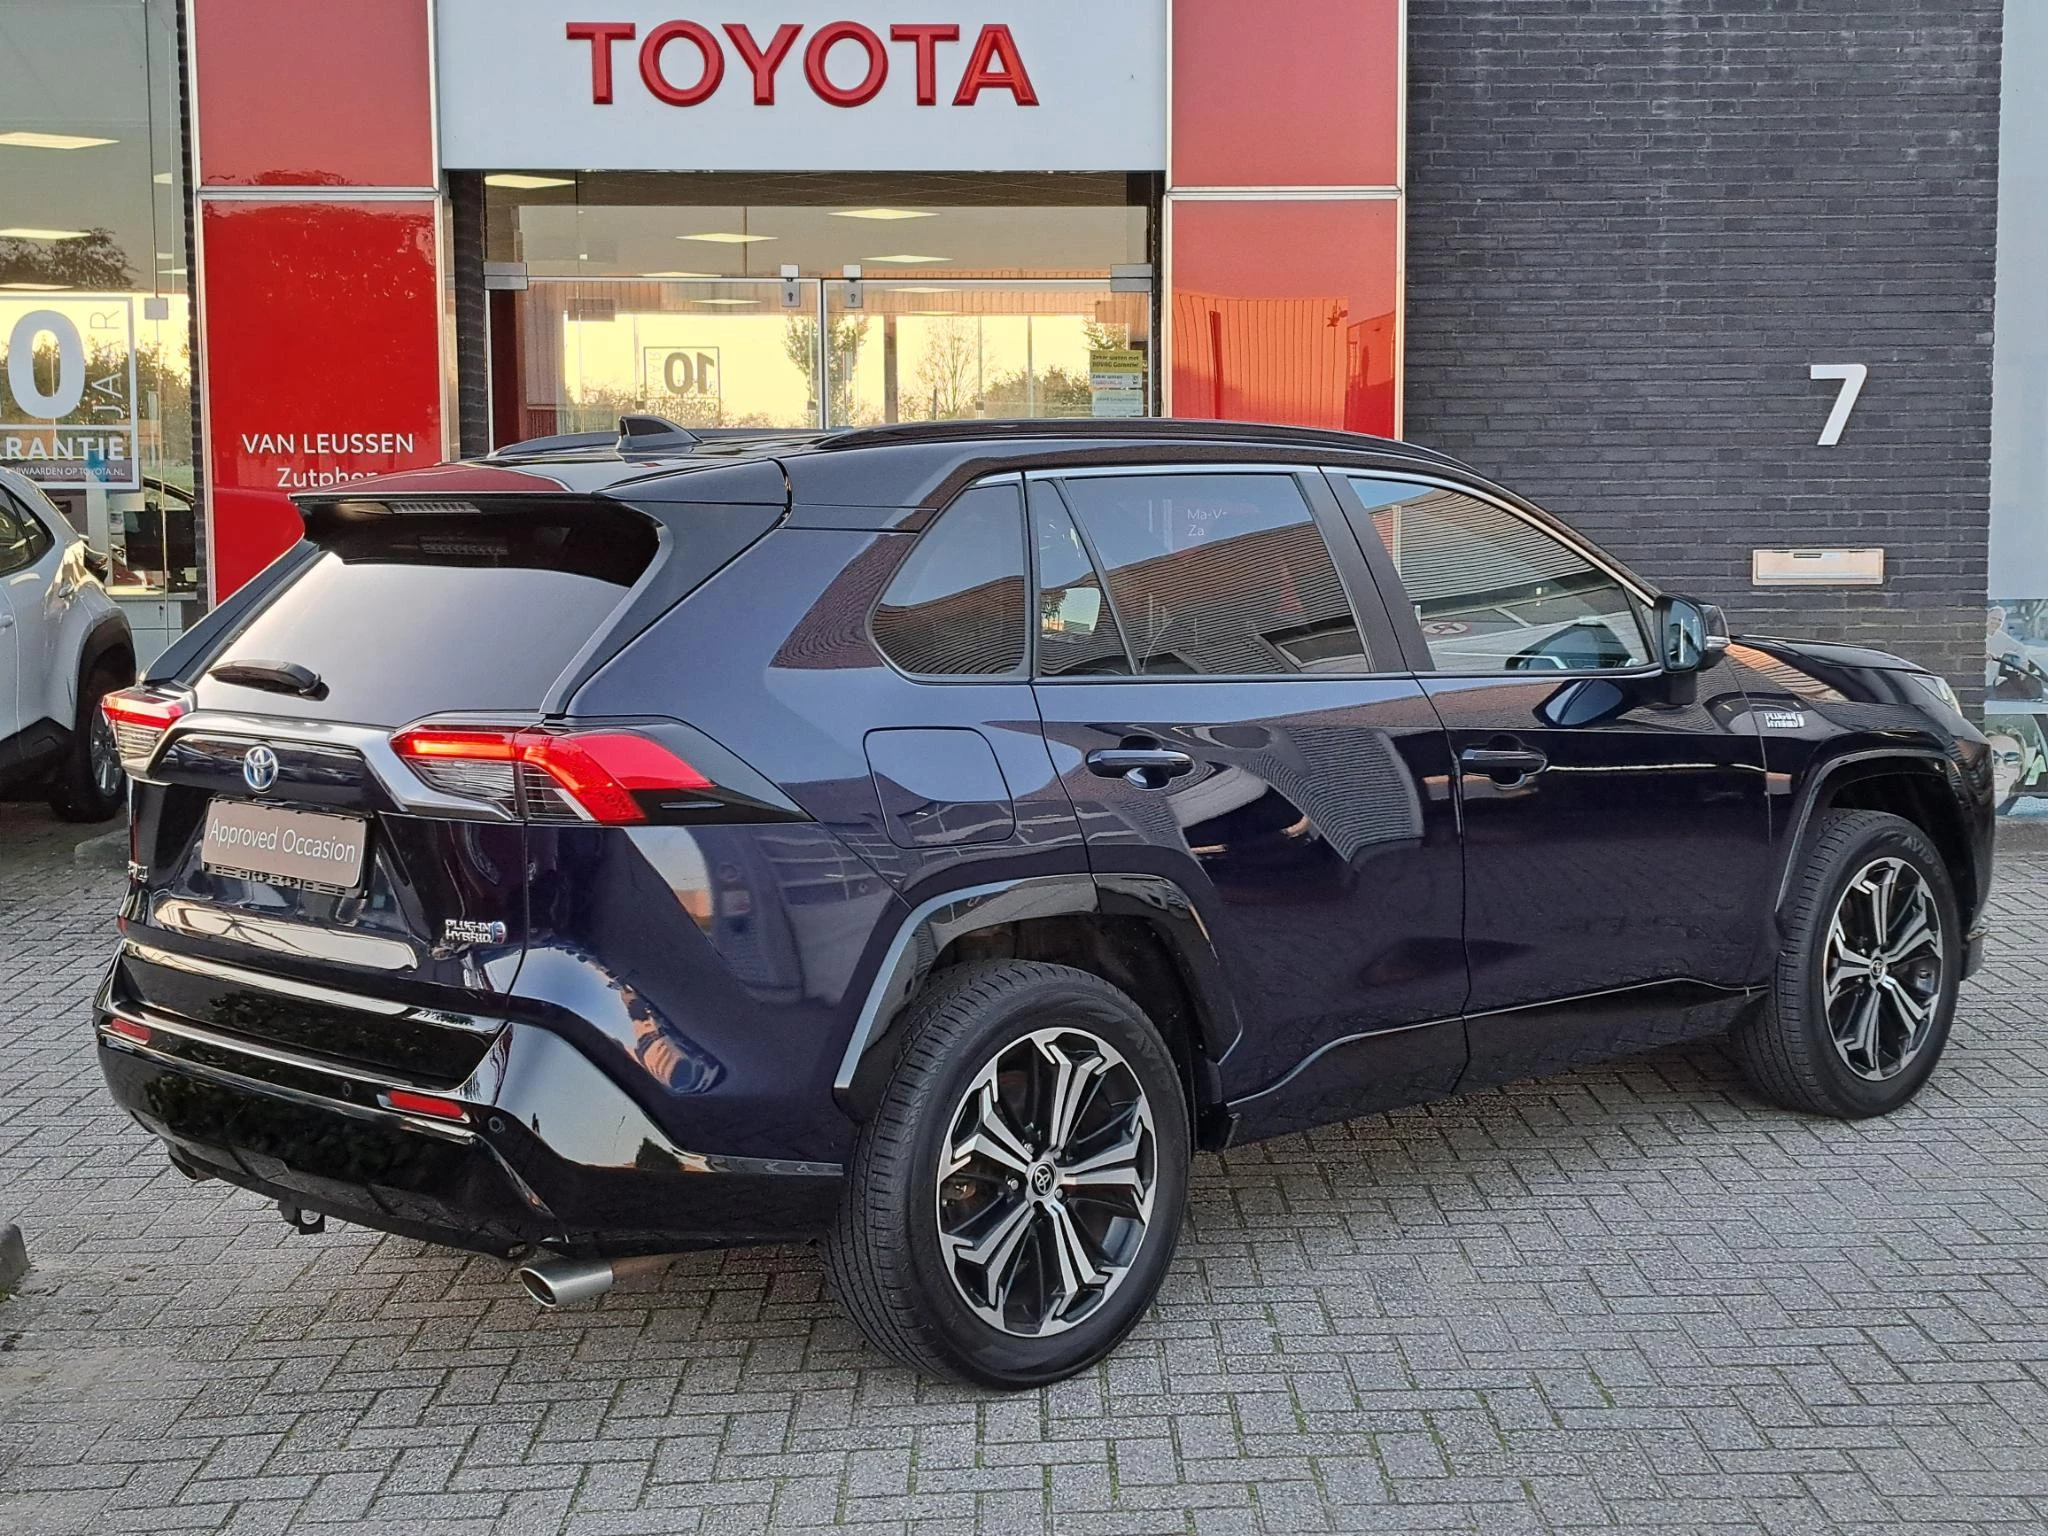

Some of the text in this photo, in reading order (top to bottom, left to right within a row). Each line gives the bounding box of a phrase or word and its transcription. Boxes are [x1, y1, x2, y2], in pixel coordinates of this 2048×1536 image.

[566, 19, 1040, 108] TOYOTA
[0, 310, 86, 419] 0
[1809, 364, 1867, 446] 7
[0, 437, 124, 461] RANTIE
[242, 433, 414, 454] VAN LEUSSEN
[65, 467, 77, 476] OP
[79, 467, 125, 476] TOYOTA.NL
[1188, 524, 1205, 536] Za
[209, 817, 355, 864] Approved Occasion
[445, 918, 491, 932] PLUG-IN
[445, 929, 492, 943] HYBRID
